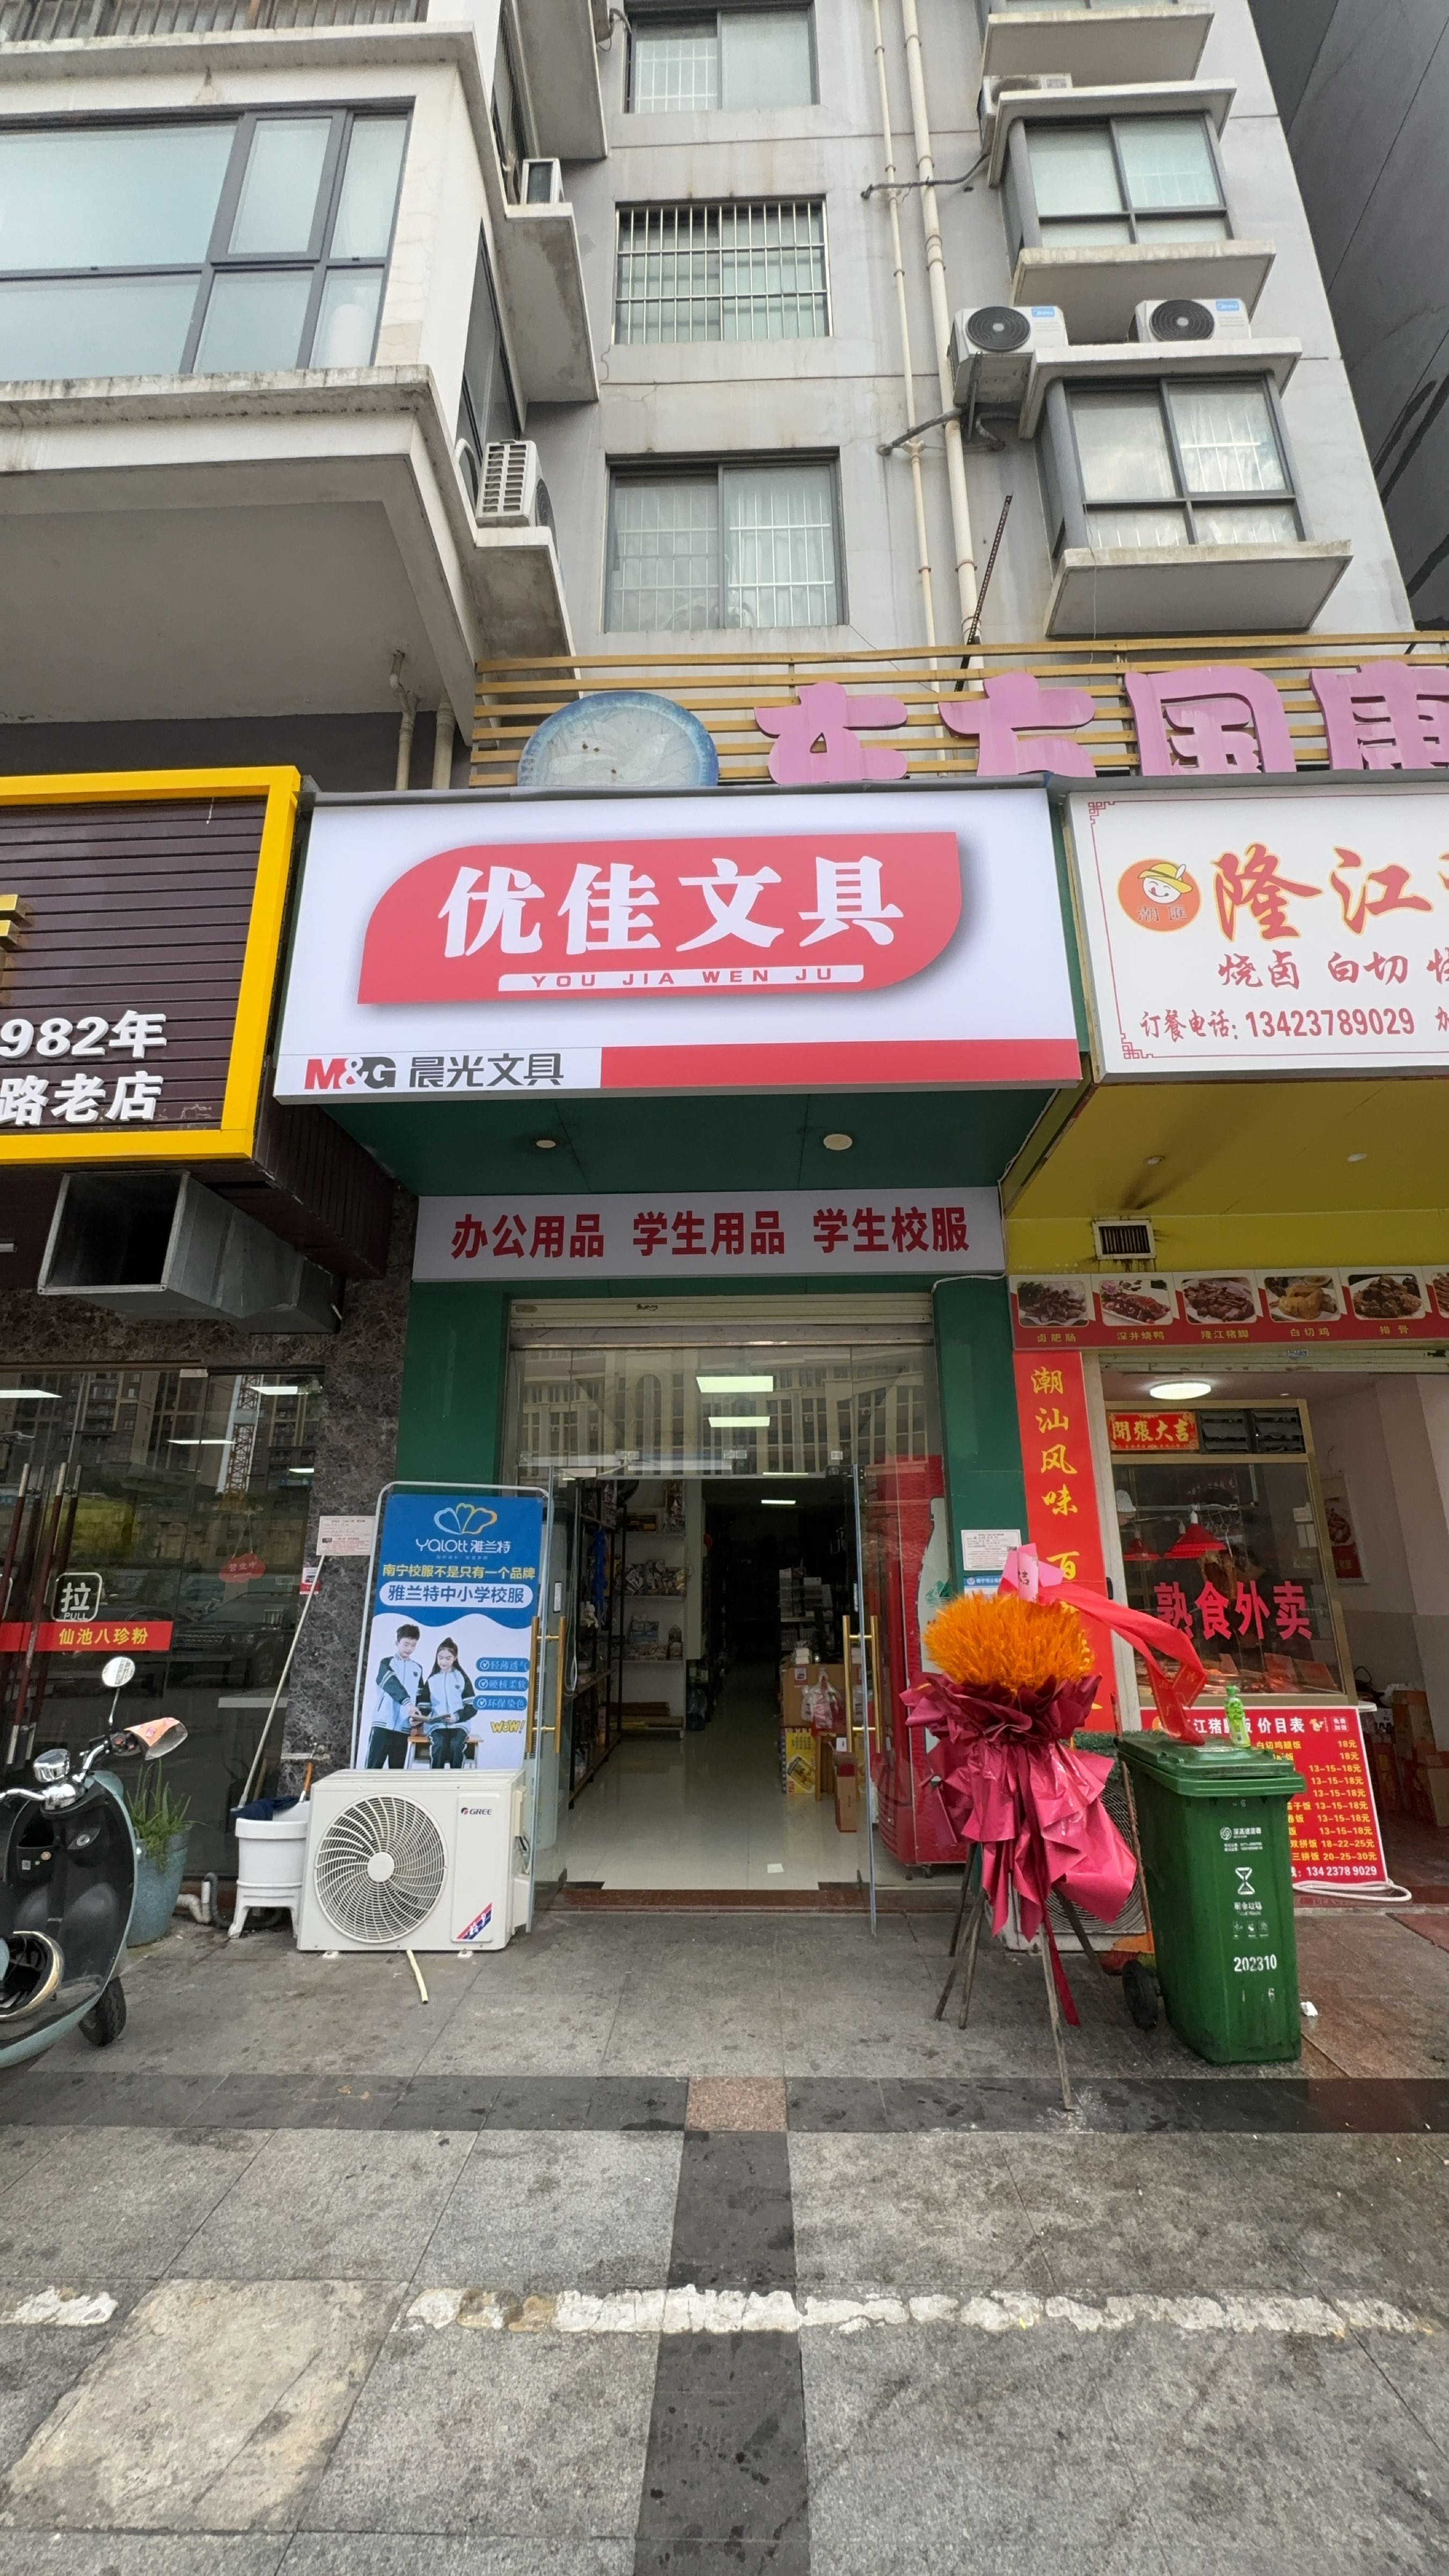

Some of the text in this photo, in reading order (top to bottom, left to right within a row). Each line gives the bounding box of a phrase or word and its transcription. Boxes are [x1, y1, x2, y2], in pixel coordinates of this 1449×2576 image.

[1211, 843, 1449, 942] 隆江
[438, 855, 904, 958] 优佳文具
[532, 968, 832, 988] YOU JIA WEN JU
[1218, 949, 1300, 990] 烧卤
[1328, 952, 1408, 985] 白切
[304, 1053, 564, 1089] M&G 晨光文具
[0, 1071, 163, 1125] 路老店
[450, 1206, 970, 1261] 办公用品 学生用品 学生校服
[1290, 1327, 1330, 1337] 白切鸡
[1380, 1324, 1409, 1335] 排骨
[470, 1539, 511, 1554] 雅兰特
[383, 1563, 536, 1579] 南宁校服不是只有一个品牌
[61, 1582, 91, 1613] 拉
[388, 1584, 524, 1604] 雅兰特中小学校服
[63, 1612, 89, 1620] PULL
[1154, 1580, 1312, 1641] 熟食外卖
[59, 1627, 148, 1645] 仙池八珍粉
[1258, 1717, 1305, 1734] 价目表
[1338, 1740, 1358, 1748] 18元
[1340, 1752, 1360, 1760] 18元
[1233, 1953, 1277, 1972] 202310
